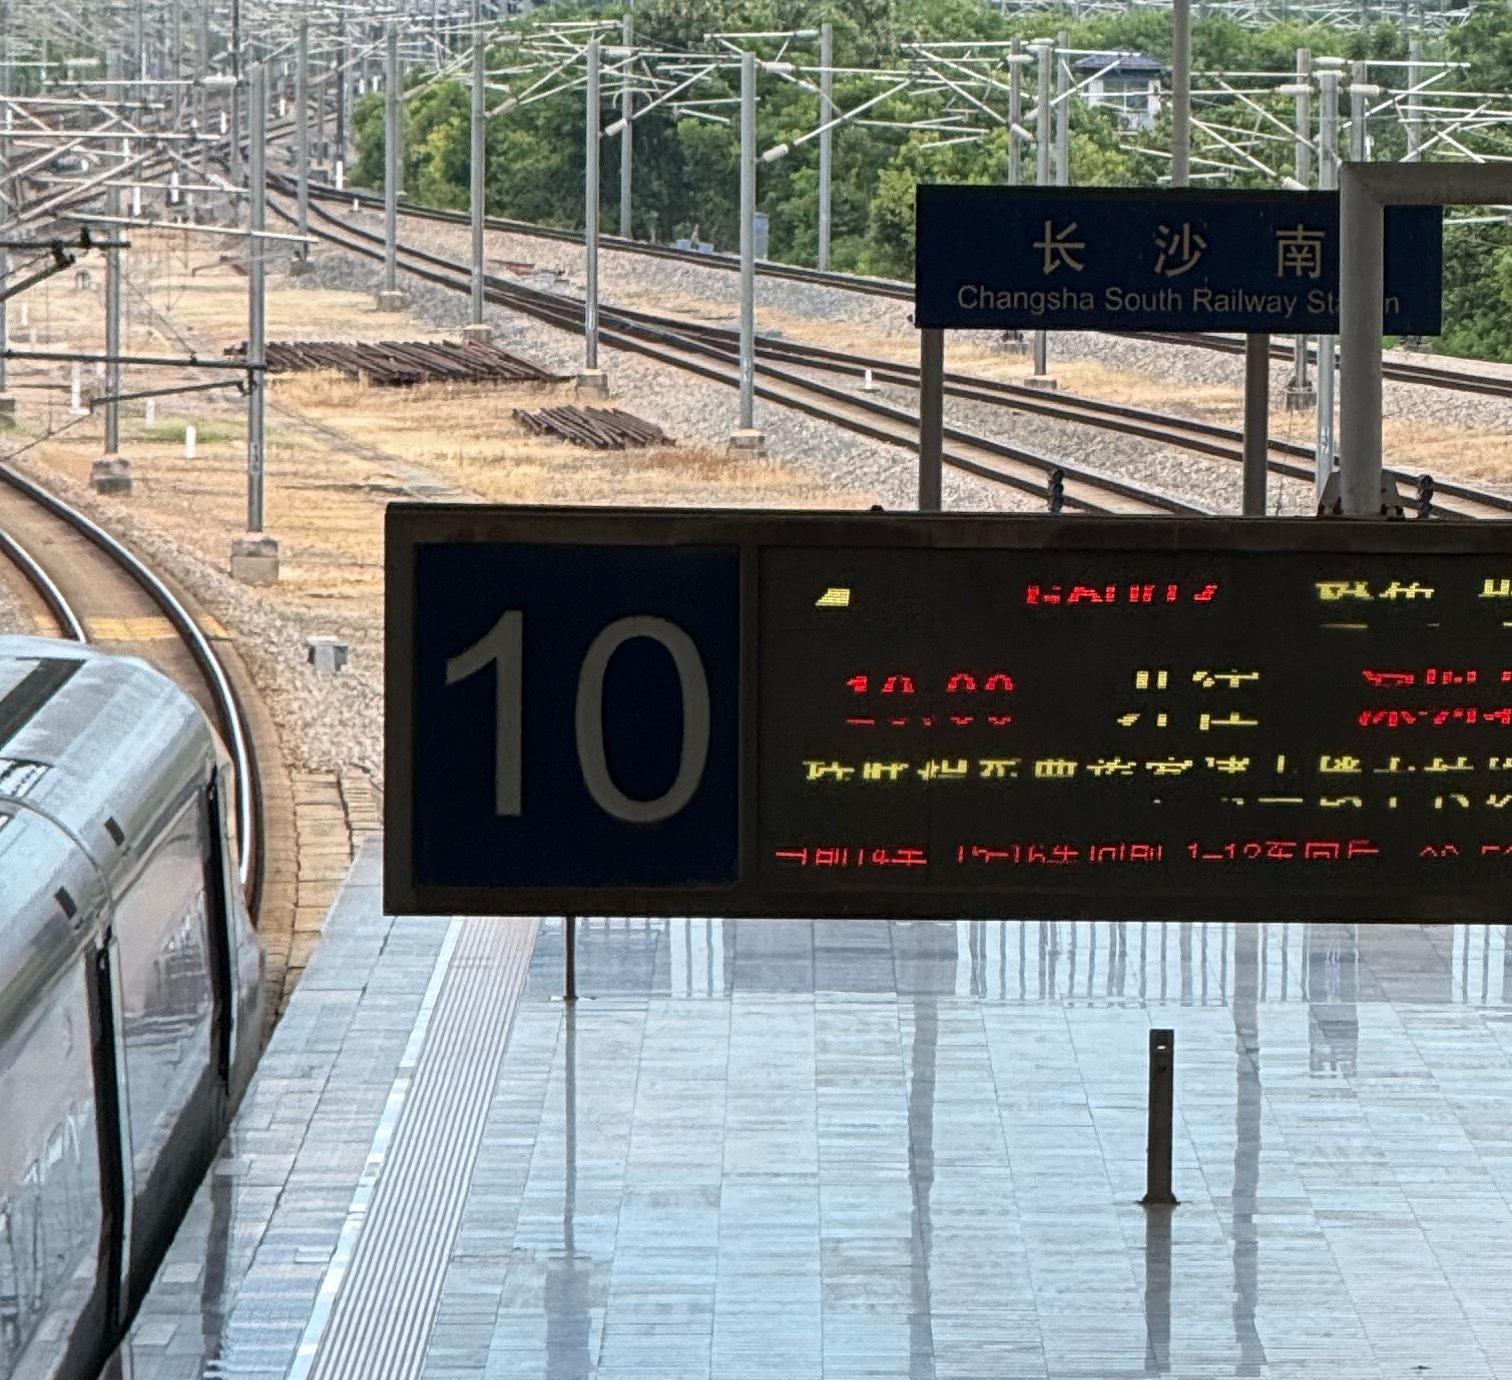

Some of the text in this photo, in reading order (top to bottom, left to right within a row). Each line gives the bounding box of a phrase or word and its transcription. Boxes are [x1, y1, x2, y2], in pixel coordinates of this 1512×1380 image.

[1033, 219, 1325, 279] 长沙南
[957, 285, 1094, 316] Changsha
[1105, 286, 1182, 311] South
[1193, 288, 1297, 317] Railway
[445, 609, 711, 823] 10
